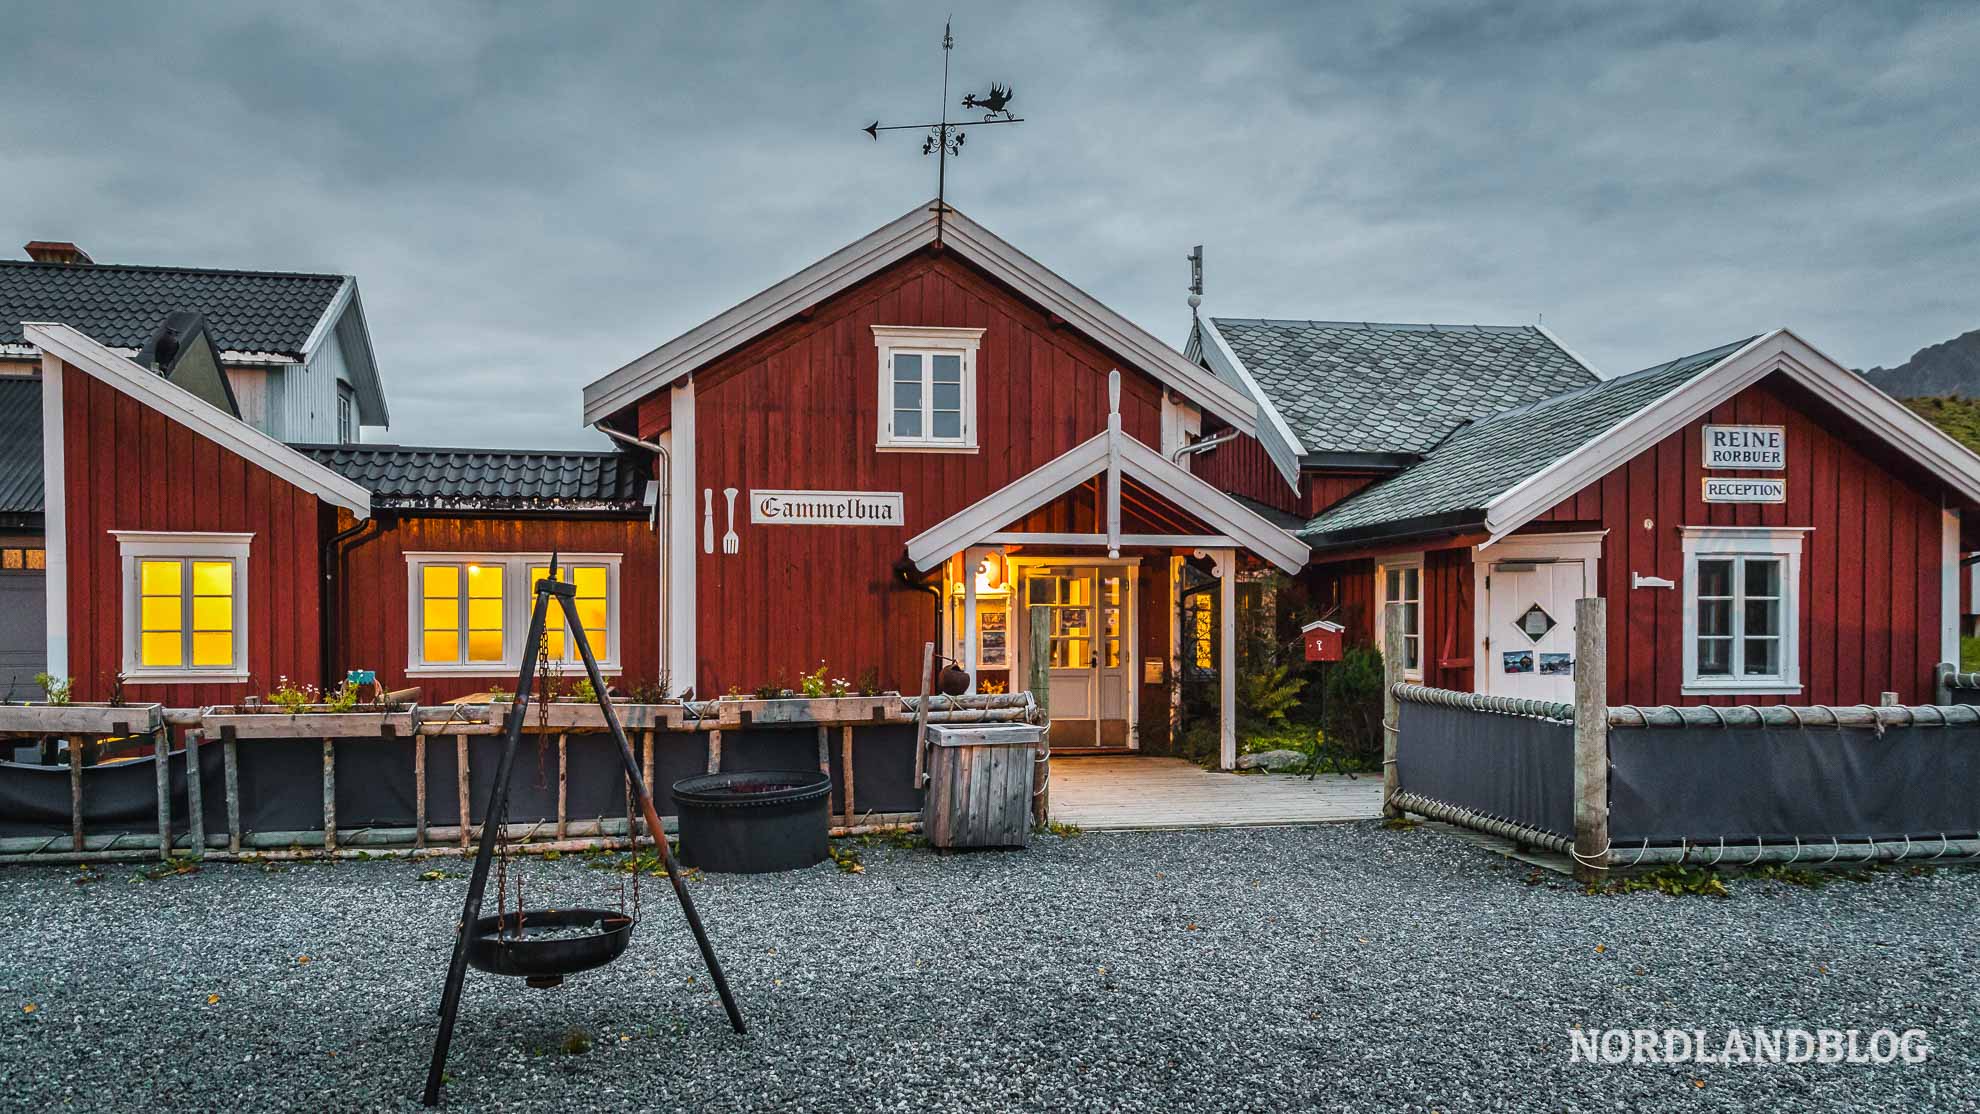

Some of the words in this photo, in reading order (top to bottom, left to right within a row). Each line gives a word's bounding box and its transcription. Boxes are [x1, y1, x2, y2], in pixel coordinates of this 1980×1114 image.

[1713, 431, 1780, 448] REINE
[1713, 450, 1781, 463] RORBUER
[1708, 483, 1782, 496] RECEPTION
[760, 497, 893, 520] Gammelbua
